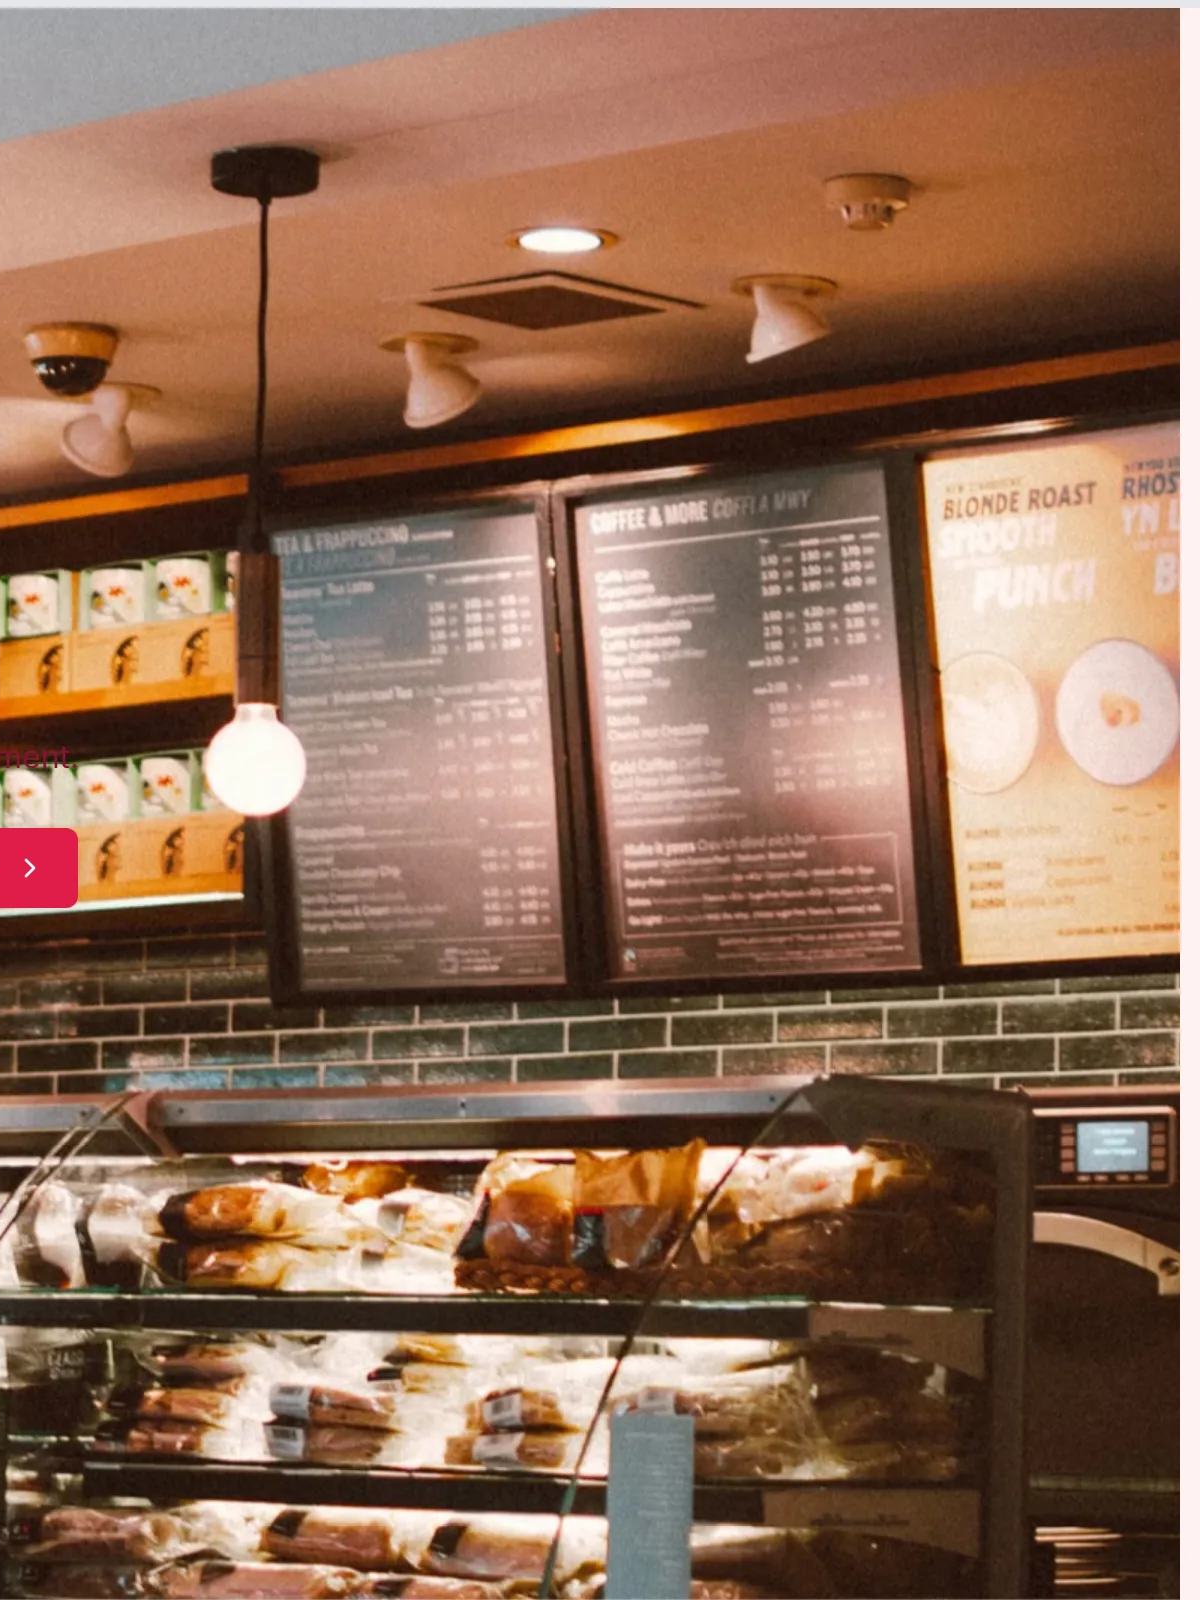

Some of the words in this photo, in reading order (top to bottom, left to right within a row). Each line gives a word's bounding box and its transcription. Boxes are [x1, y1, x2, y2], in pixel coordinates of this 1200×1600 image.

[591, 507, 646, 534] COFFEE
[649, 505, 662, 528] &
[664, 500, 709, 526] MORE
[943, 490, 1020, 521] BLONDE
[1028, 481, 1097, 511] ROAST
[315, 523, 410, 551] FRAPPUCCINO
[972, 558, 1097, 613] PUNCH
